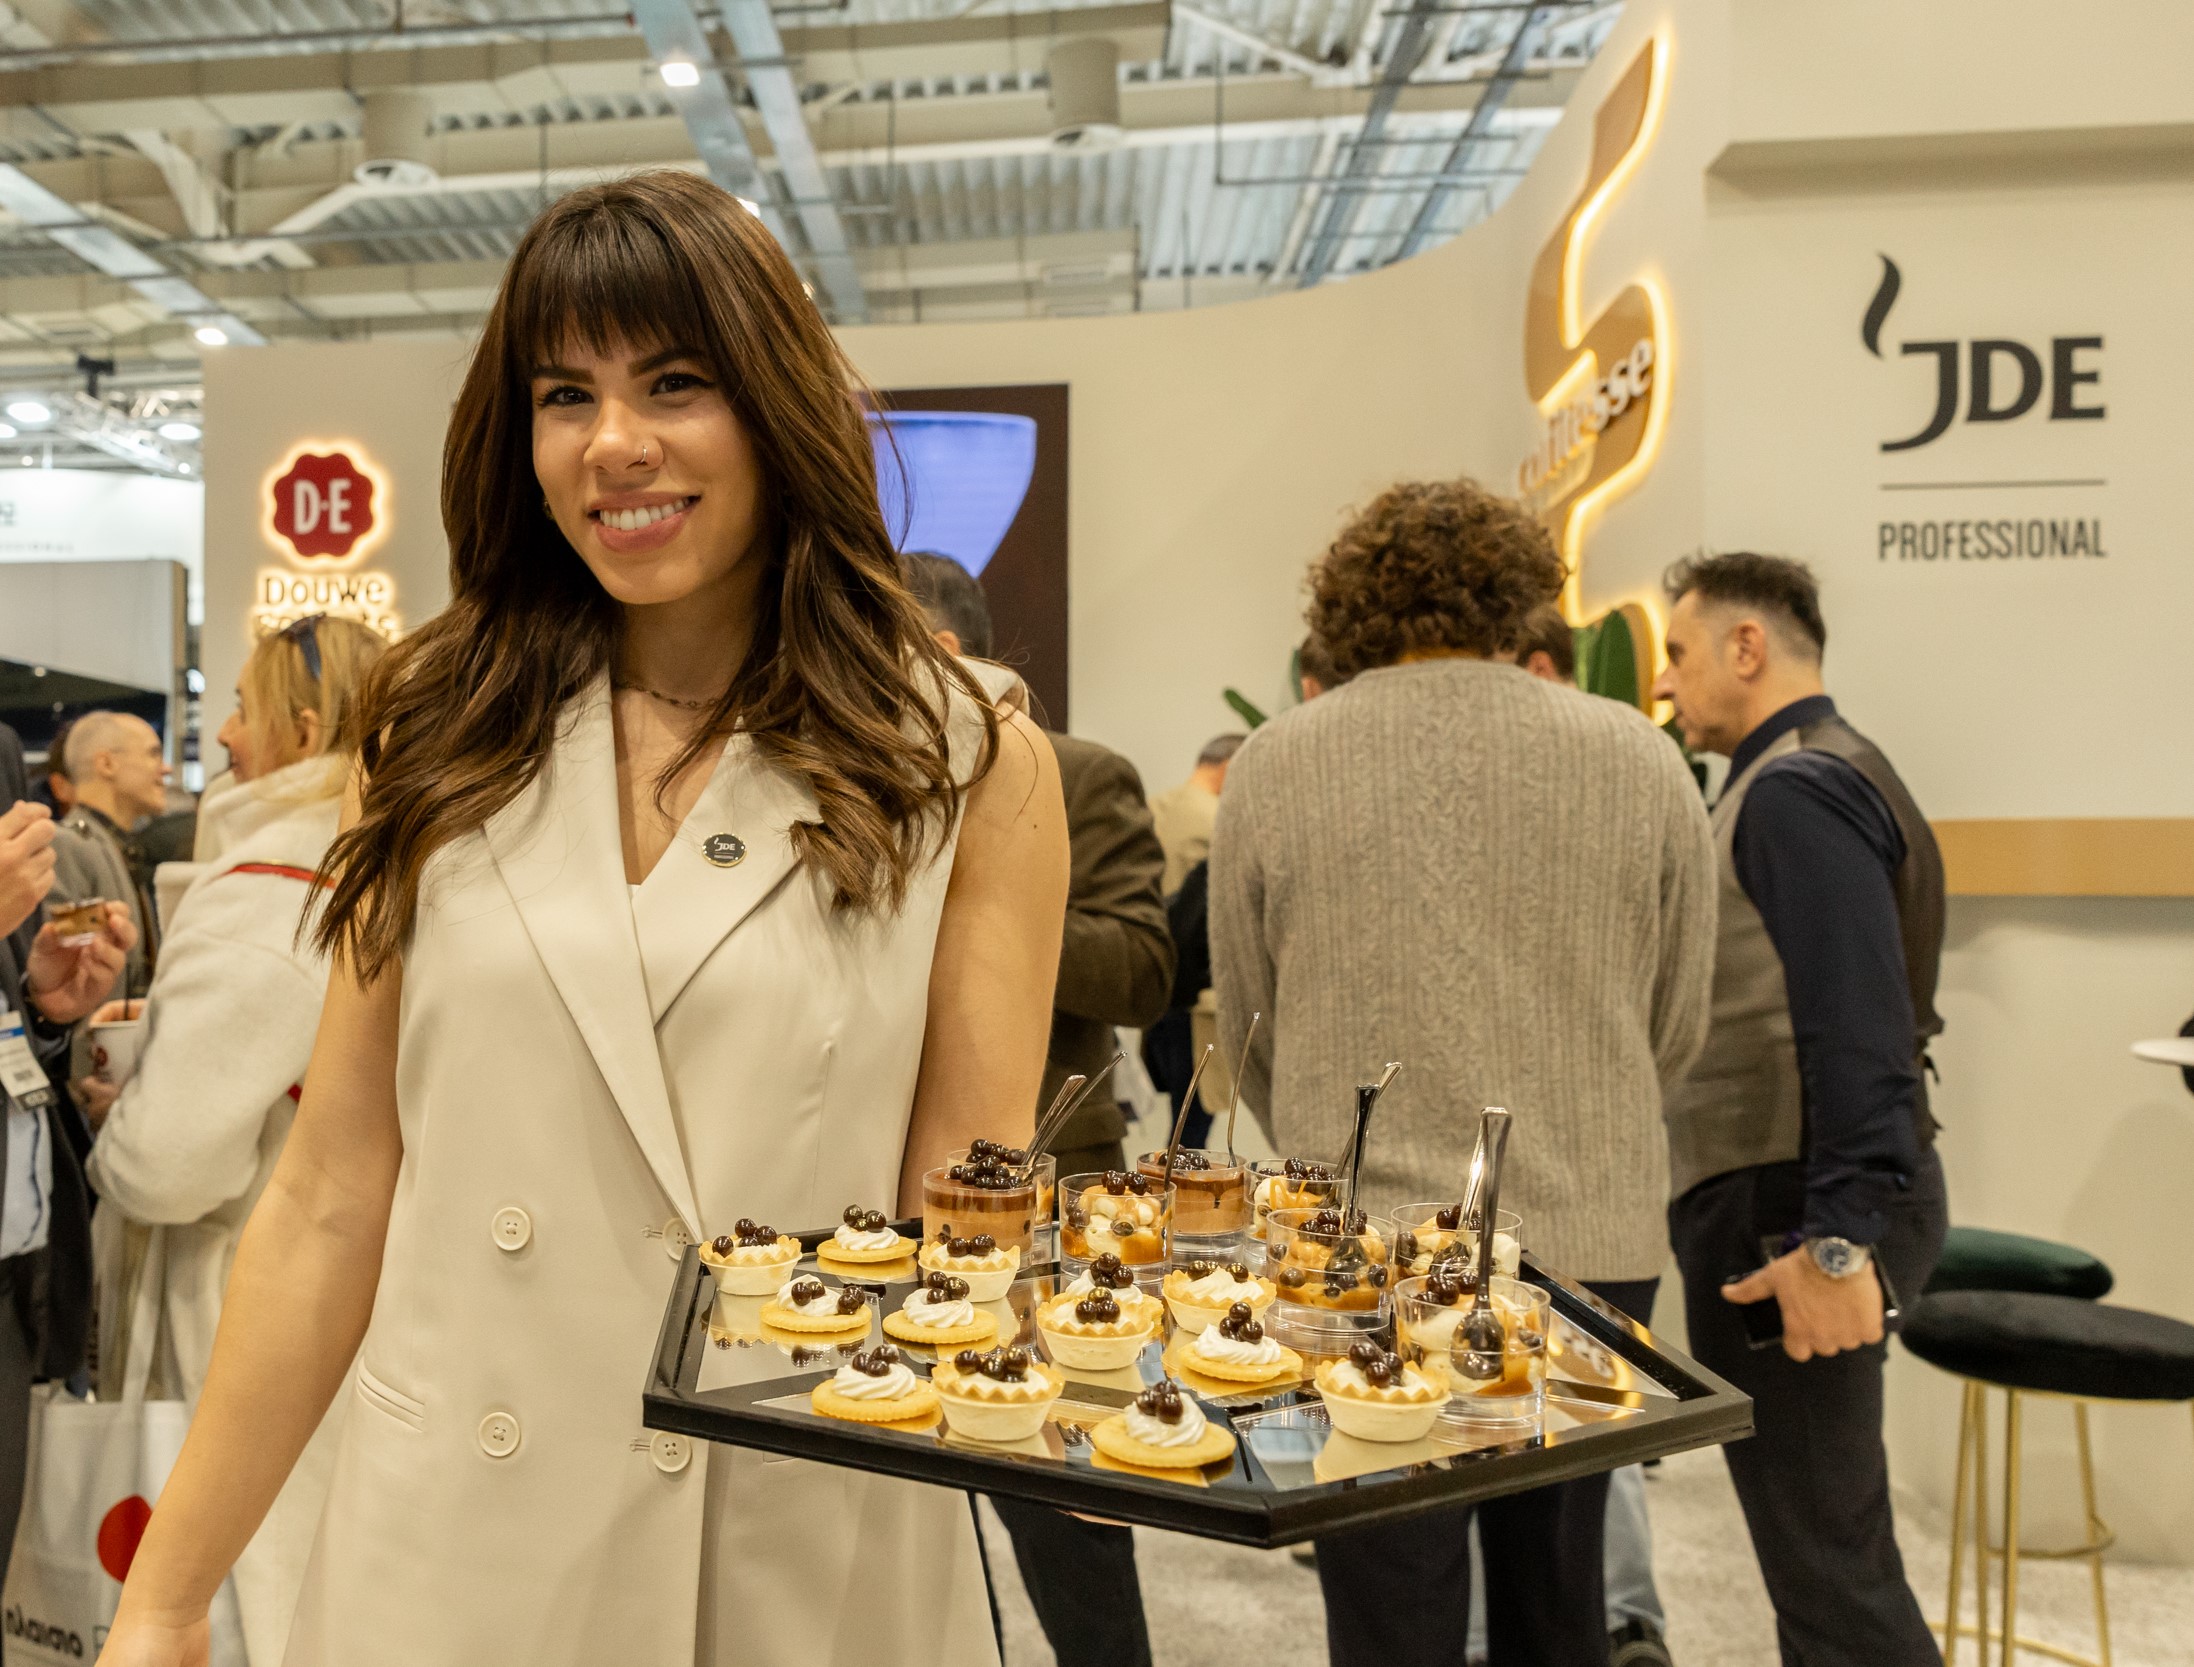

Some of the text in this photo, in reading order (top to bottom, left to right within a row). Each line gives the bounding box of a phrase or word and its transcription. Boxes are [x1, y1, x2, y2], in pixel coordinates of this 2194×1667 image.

[1878, 336, 2106, 452] JDE
[1878, 518, 2107, 562] PROFESSIONAL
[266, 576, 384, 605] Douwe
[714, 842, 736, 852] JDE
